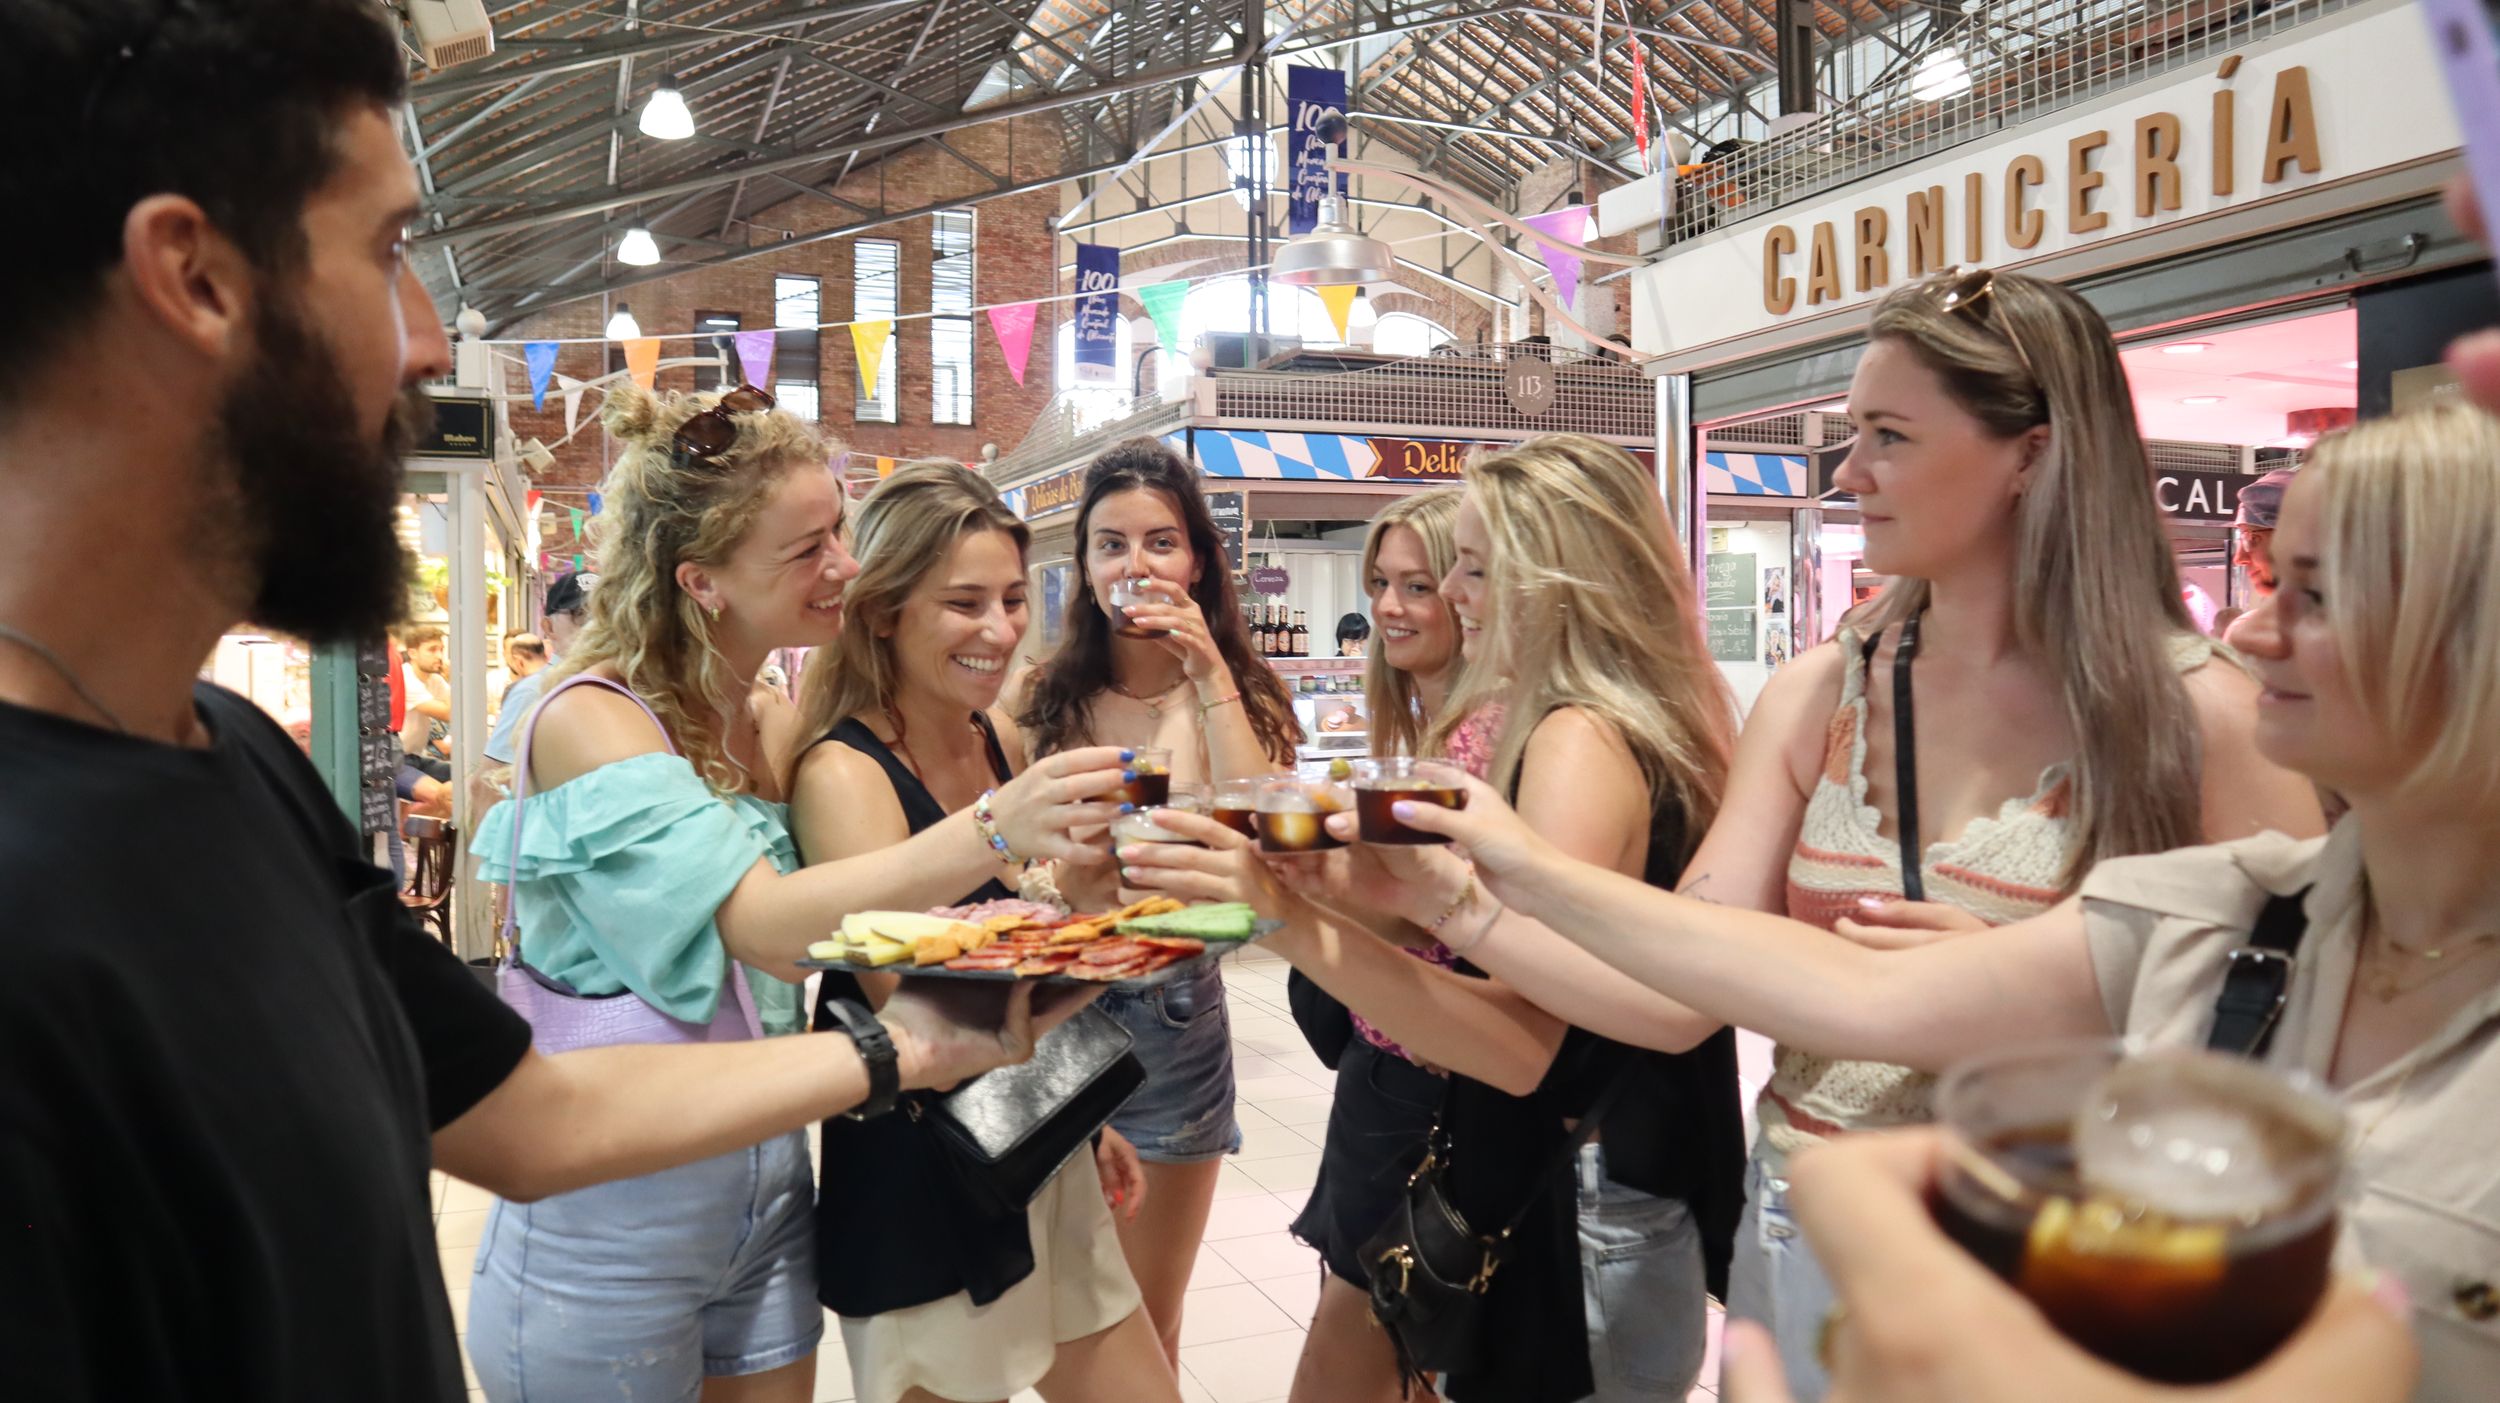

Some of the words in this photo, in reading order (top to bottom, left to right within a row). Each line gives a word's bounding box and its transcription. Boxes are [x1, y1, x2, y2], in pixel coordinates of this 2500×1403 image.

[1762, 55, 2321, 316] CARNICERÍA
[1081, 269, 1115, 291] 100
[1518, 375, 1542, 398] 113
[1402, 441, 1468, 475] Delic
